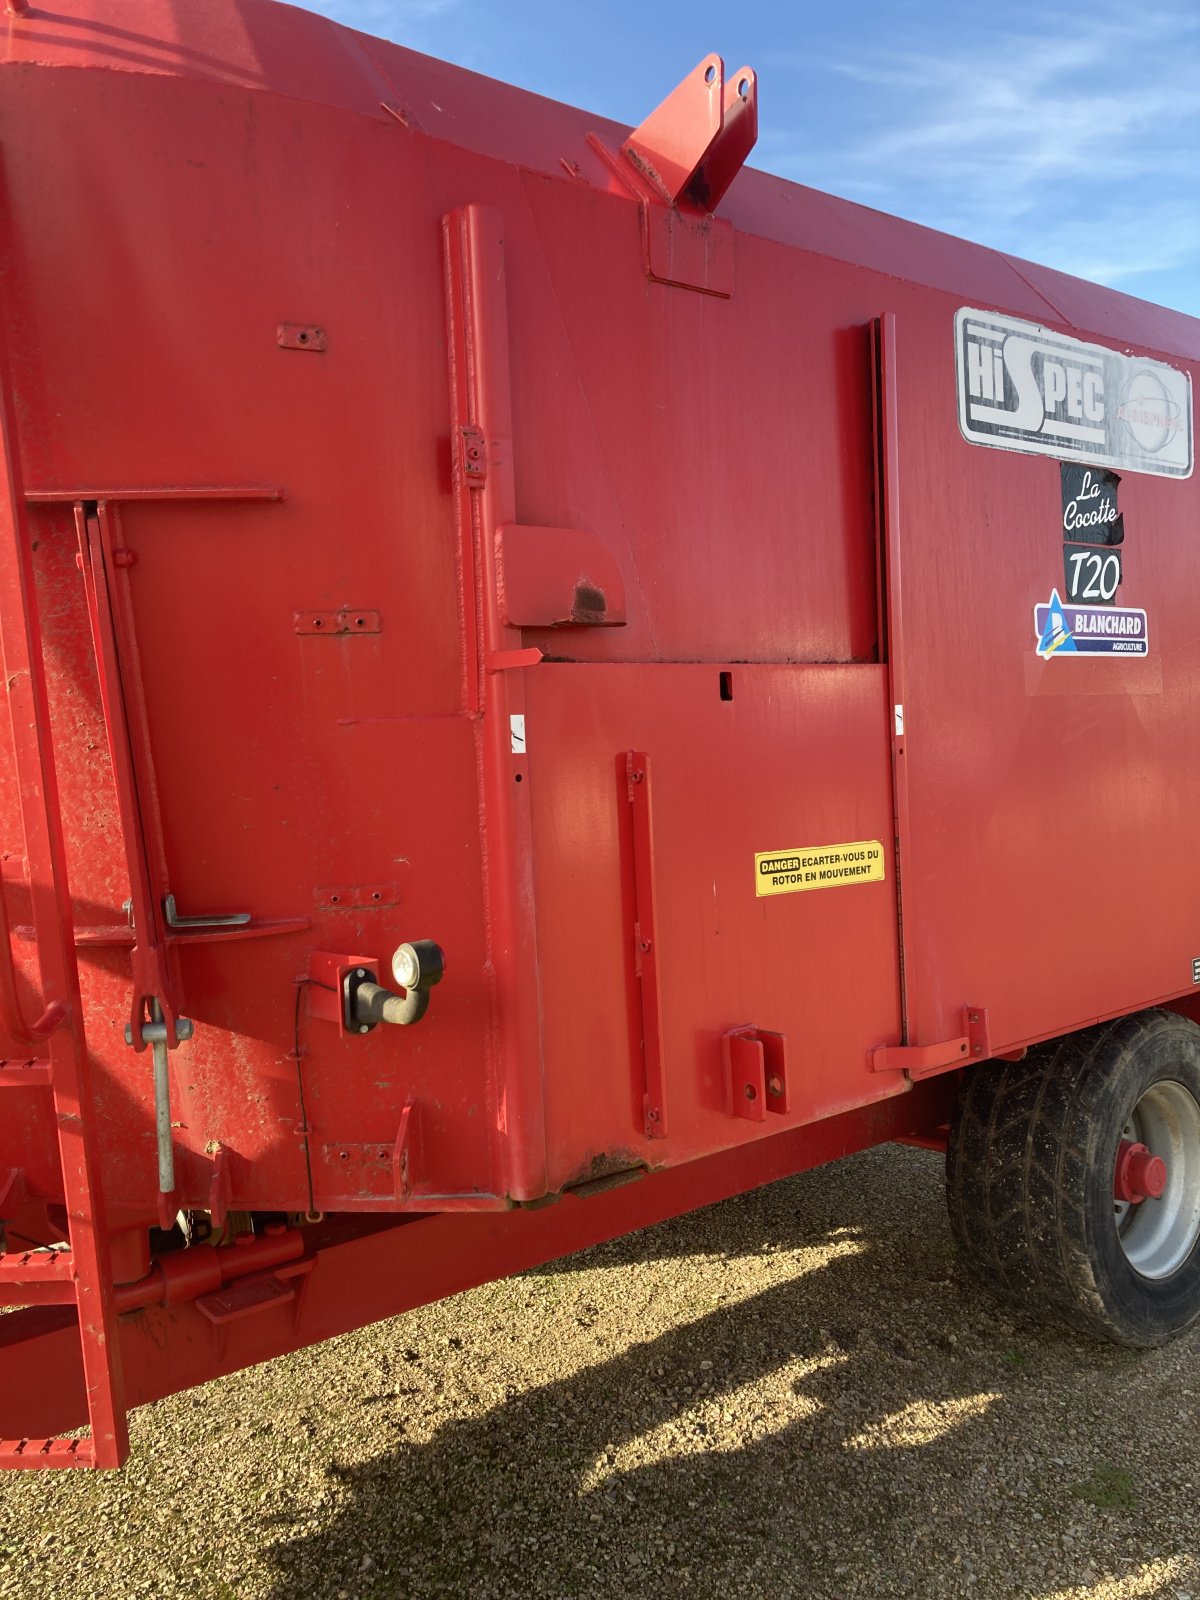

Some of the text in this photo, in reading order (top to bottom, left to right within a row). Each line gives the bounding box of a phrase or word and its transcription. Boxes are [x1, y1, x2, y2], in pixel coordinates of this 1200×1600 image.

[1076, 471, 1101, 501] La
[1063, 498, 1118, 531] Cocotte
[1069, 551, 1120, 601] T20
[1075, 614, 1142, 636] BLANCHARD
[1112, 642, 1143, 652] AGRICULTURE
[761, 850, 879, 873] DANGER ECARTER-VOUS DU
[772, 865, 872, 886] ROTOR EN MOUVEMENT
